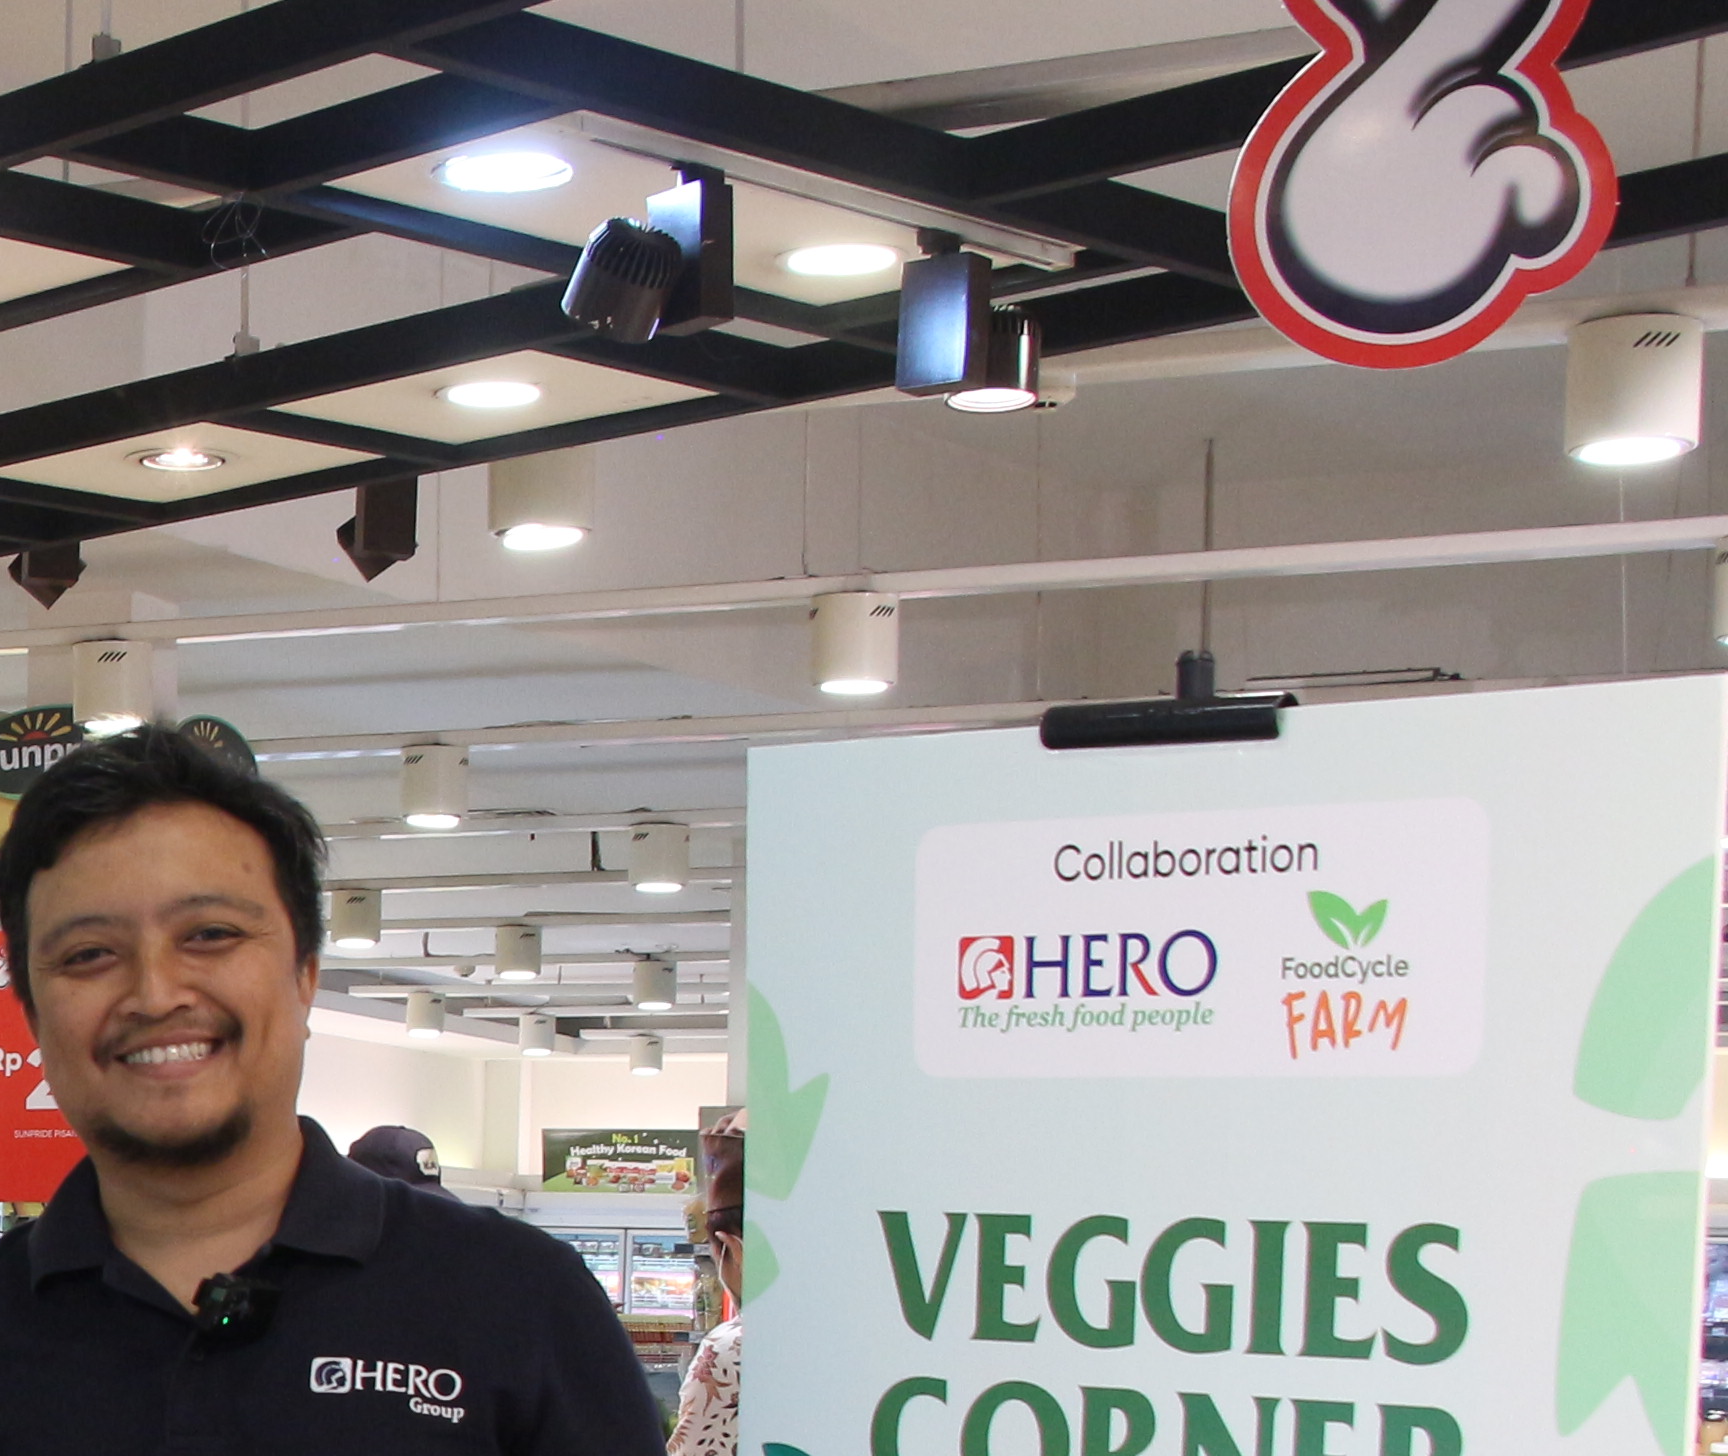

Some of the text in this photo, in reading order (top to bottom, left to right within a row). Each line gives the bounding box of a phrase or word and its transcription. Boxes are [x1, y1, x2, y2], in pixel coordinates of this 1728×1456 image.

[1053, 834, 1319, 882] Collaboration
[1024, 928, 1218, 1000] HERO
[1280, 954, 1409, 986] FoodCycle
[958, 1001, 1214, 1033] The fresh food people
[1281, 990, 1408, 1061] FARM
[14, 1129, 52, 1139] SUNPRIDE
[570, 1143, 687, 1157] Healthy Korean Food
[612, 1133, 631, 1143] No.
[876, 1209, 1468, 1366] VEGGIES
[354, 1359, 463, 1401] HERO
[409, 1397, 465, 1423] Group
